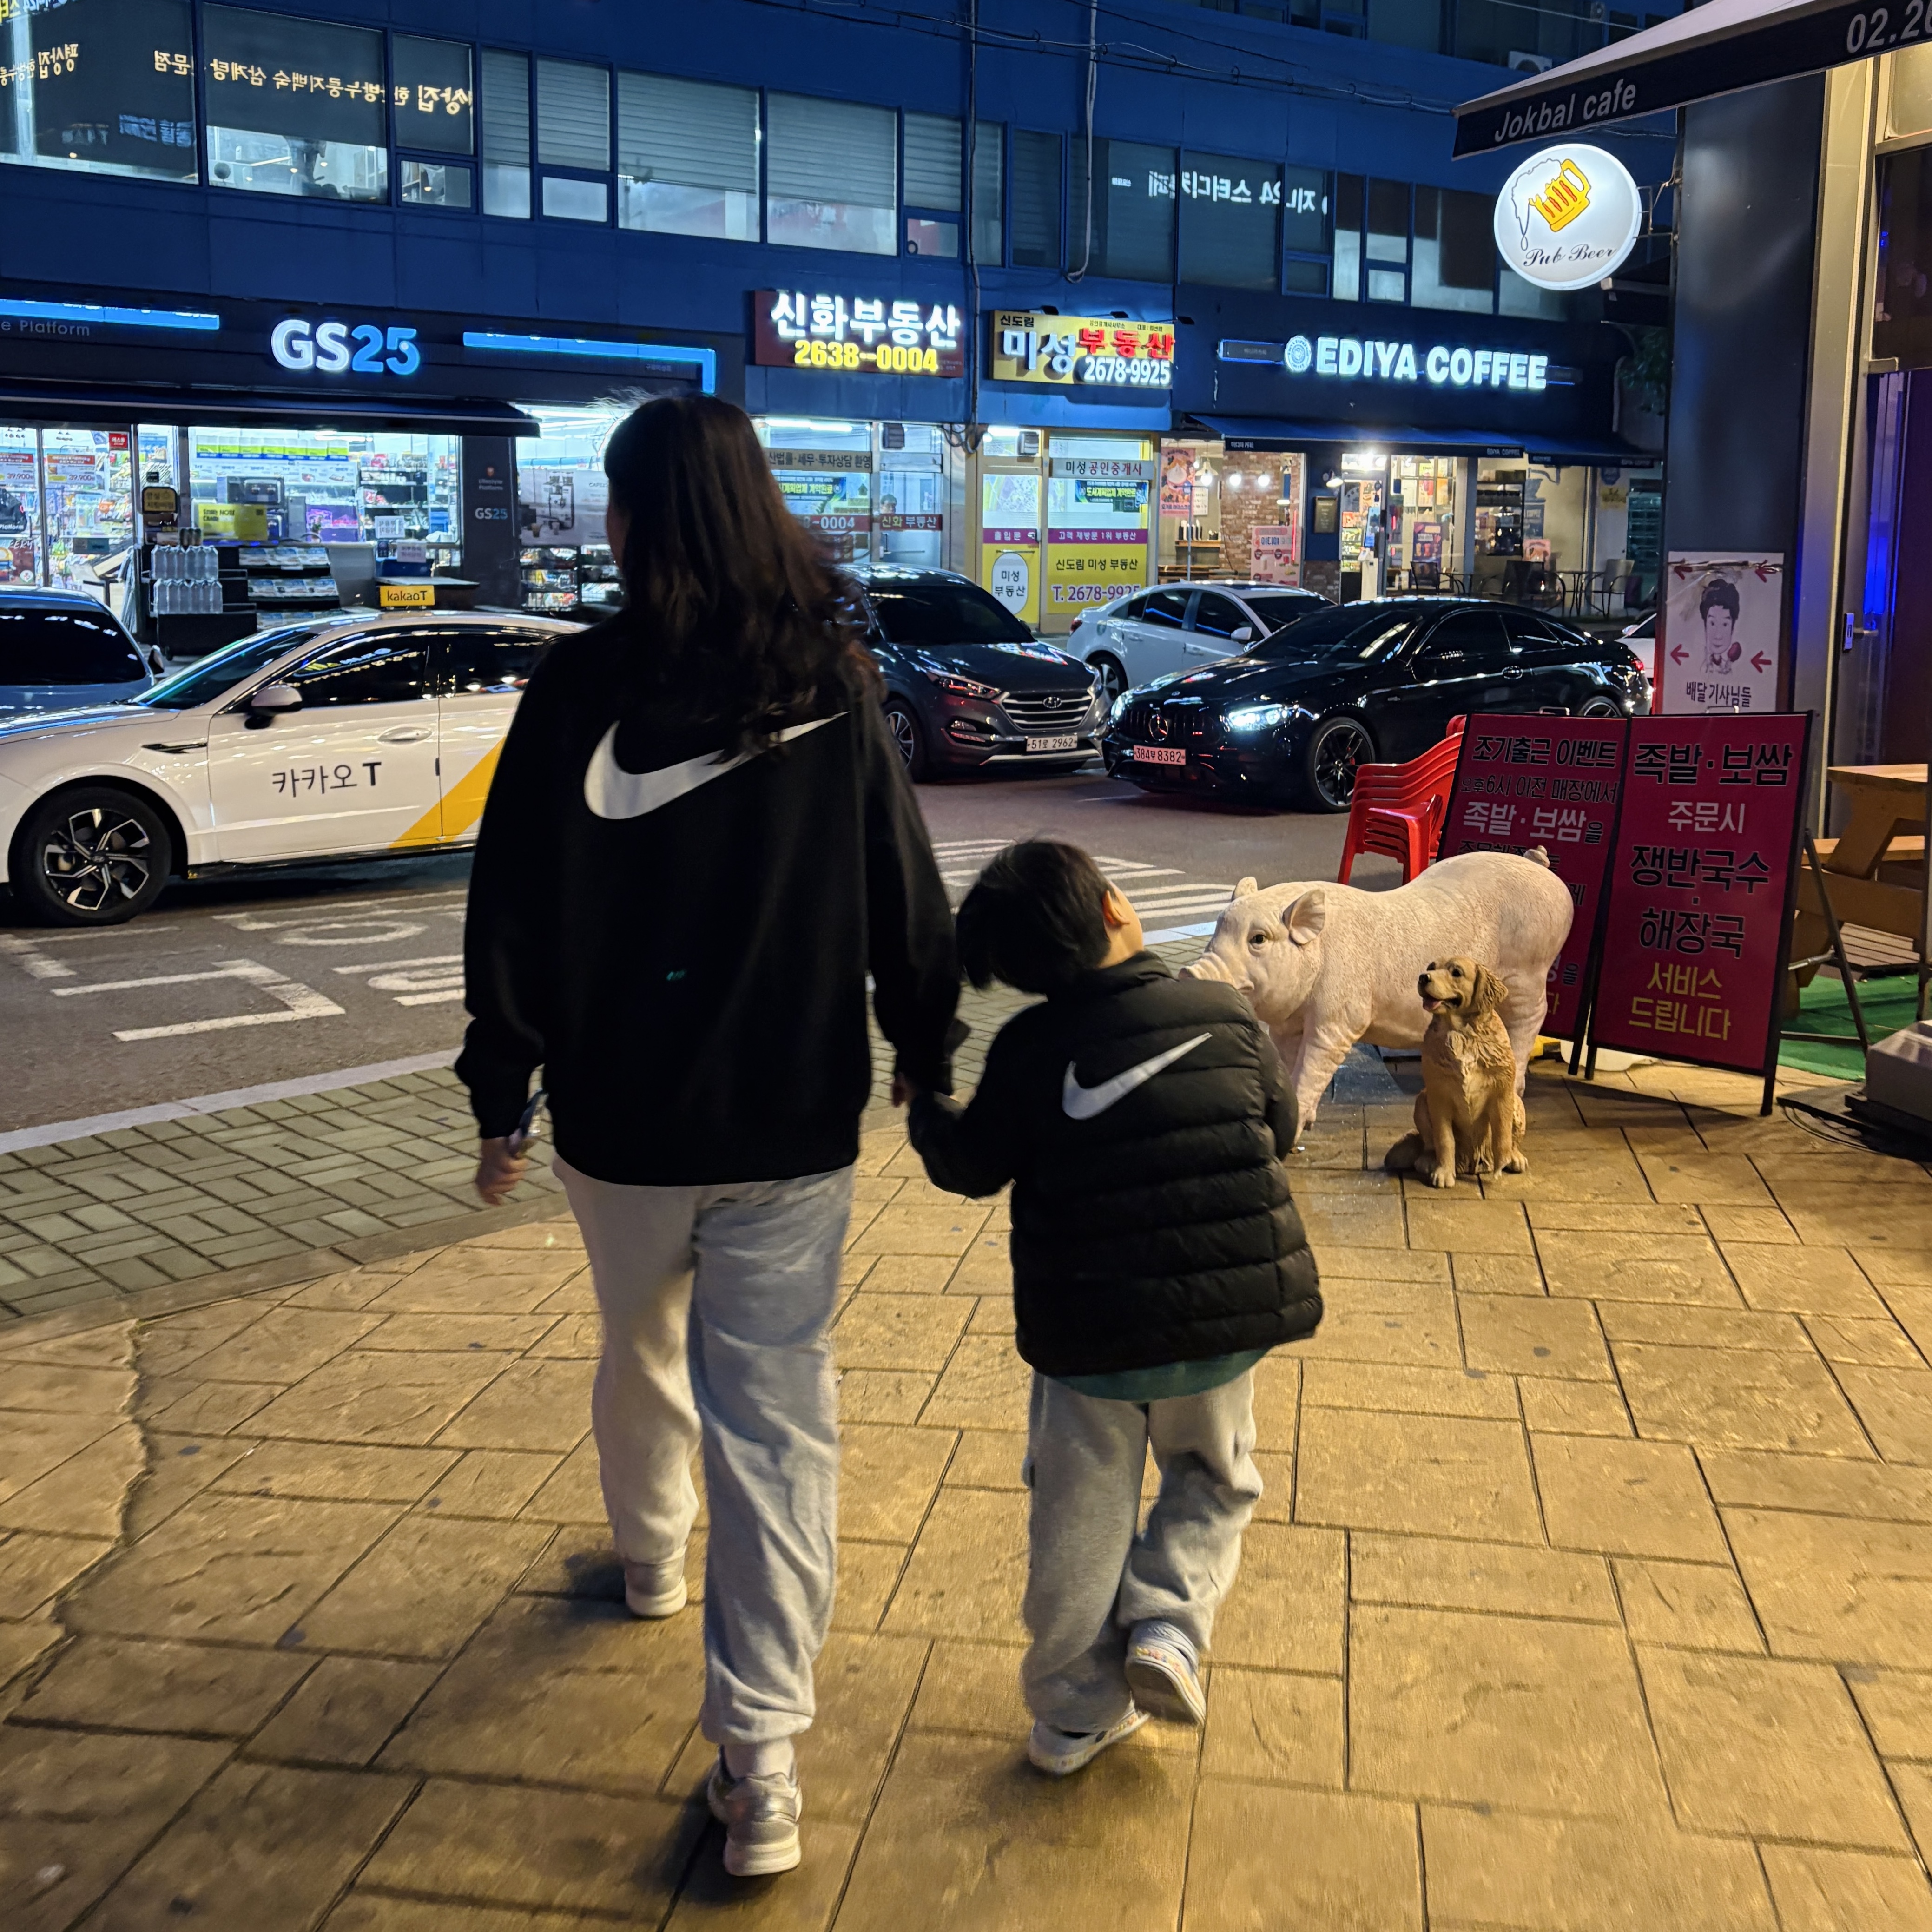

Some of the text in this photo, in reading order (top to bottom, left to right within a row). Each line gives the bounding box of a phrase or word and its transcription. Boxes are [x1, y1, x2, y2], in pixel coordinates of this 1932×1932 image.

[1495, 79, 1636, 142] Jokbal cafe
[1523, 244, 1617, 267] Pub Beer
[20, 320, 89, 336] Platform
[771, 291, 961, 348] 신화부동산
[1000, 314, 1034, 327] 신도림
[271, 319, 420, 375] GS25
[794, 339, 939, 372] 2638-0004
[1003, 327, 1175, 373] 미성 부동산
[1084, 356, 1171, 385] 2678-9925
[1316, 337, 1417, 381] EDIYA
[1427, 346, 1548, 389] COFFEE
[1066, 461, 1142, 476] 미성 공인중개사
[475, 508, 508, 520] GS25
[882, 516, 936, 528] 신화 부동산
[1001, 570, 1019, 582] 미성
[1056, 559, 1138, 571] 신도림 미성 부동산
[995, 586, 1025, 597] 부동산
[1052, 586, 1064, 601] T.
[1687, 682, 1752, 707] 배달 기사님들
[1052, 737, 1073, 749] 2962
[1157, 749, 1182, 763] 8382
[1472, 735, 1618, 768] 조기출근 이벤트
[272, 762, 382, 798] 카카오 T
[1516, 776, 1547, 799] 이전
[1551, 779, 1619, 804] 매장에서
[1668, 801, 1745, 834] 주문시
[1630, 845, 1771, 894] 쟁반국수
[1640, 906, 1746, 959] 해장국
[1647, 962, 1722, 1000] 서비스
[1629, 996, 1731, 1041] 드립니다
